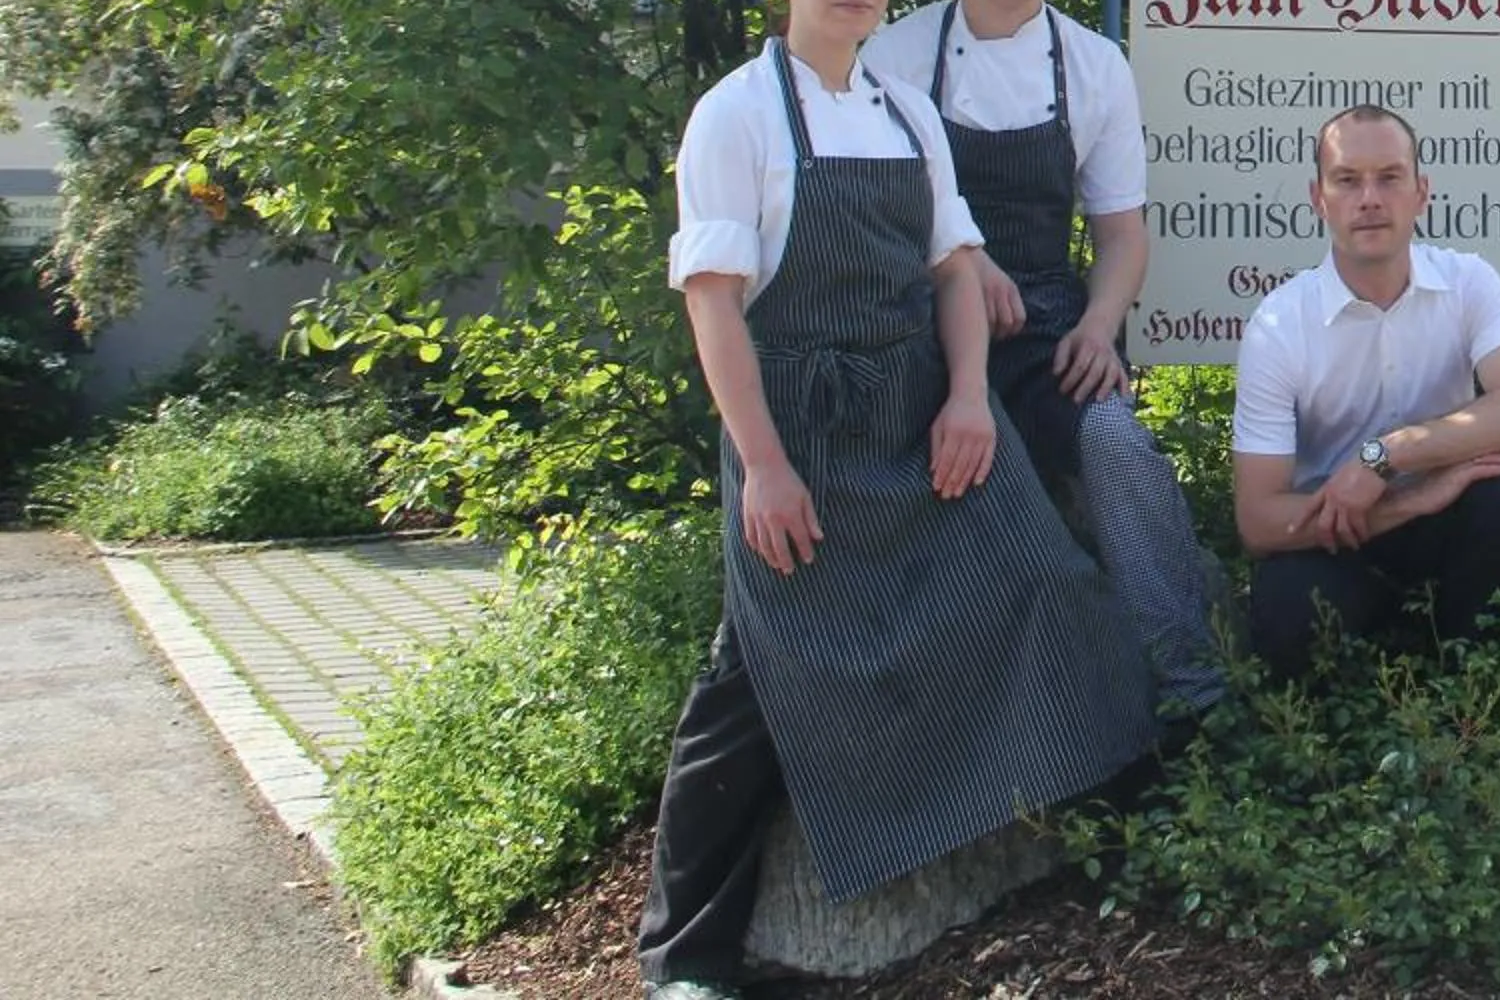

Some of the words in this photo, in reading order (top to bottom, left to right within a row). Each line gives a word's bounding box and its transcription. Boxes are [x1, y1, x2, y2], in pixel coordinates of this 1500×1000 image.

[1184, 67, 1423, 110] Gästezimmer
[1440, 73, 1492, 110] mit
[1141, 124, 1318, 173] behaglich
